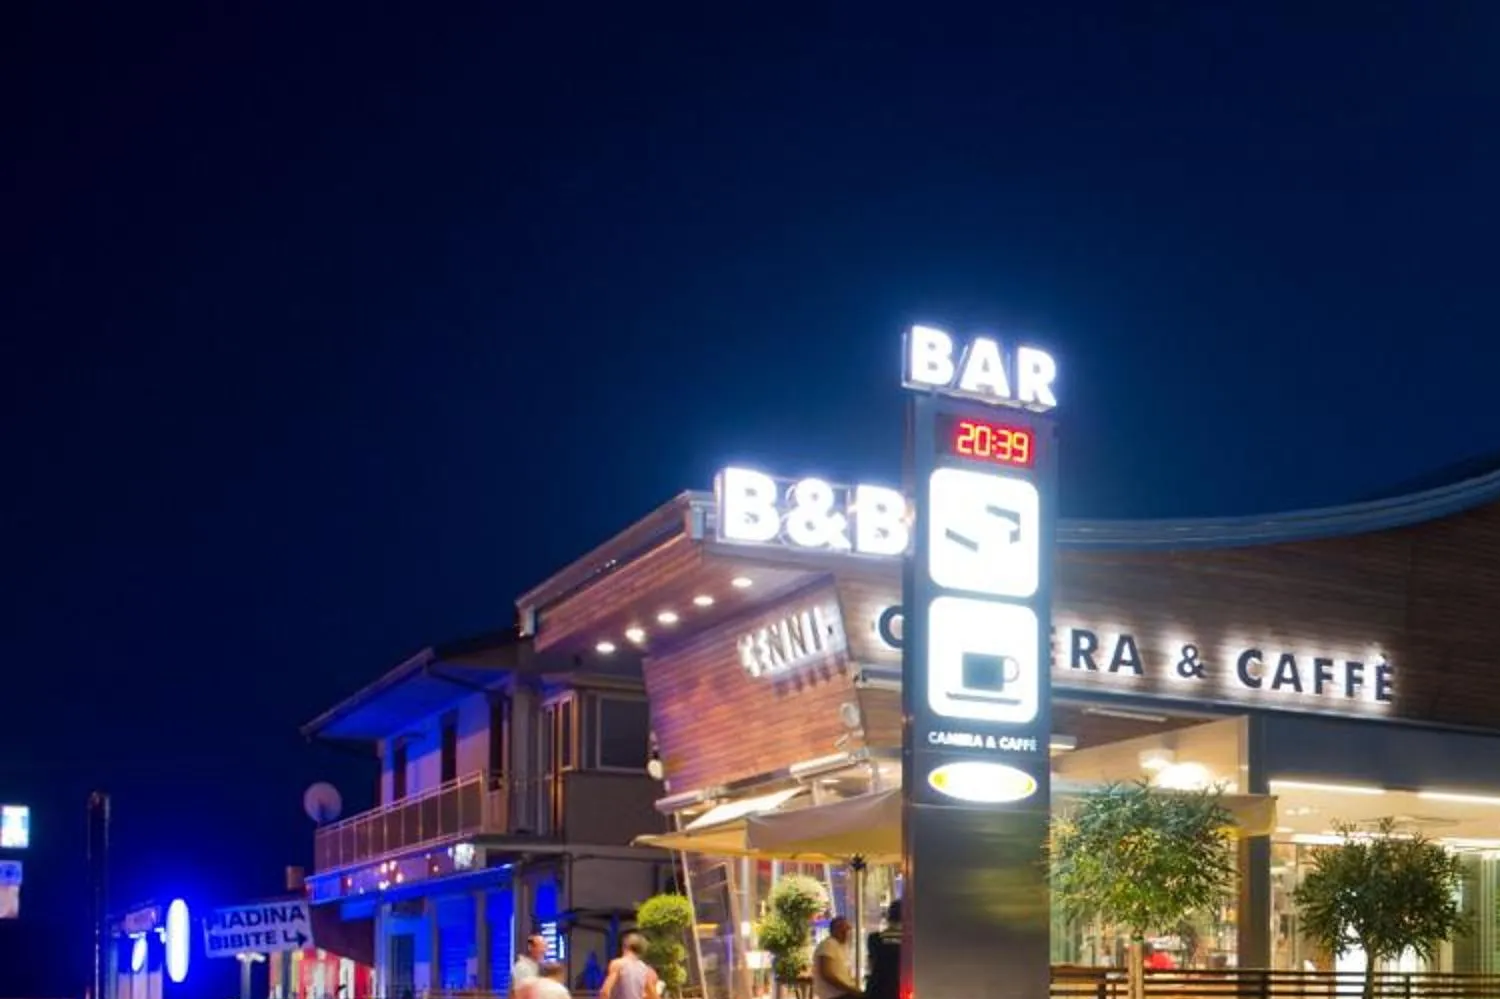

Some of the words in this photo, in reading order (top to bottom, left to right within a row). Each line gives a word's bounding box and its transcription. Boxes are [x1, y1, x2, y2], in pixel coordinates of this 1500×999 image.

[910, 325, 1057, 408] BAR
[956, 421, 1029, 463] 20:39
[719, 466, 910, 556] B&B
[1176, 644, 1204, 679] &
[208, 930, 277, 951] BIBITE
